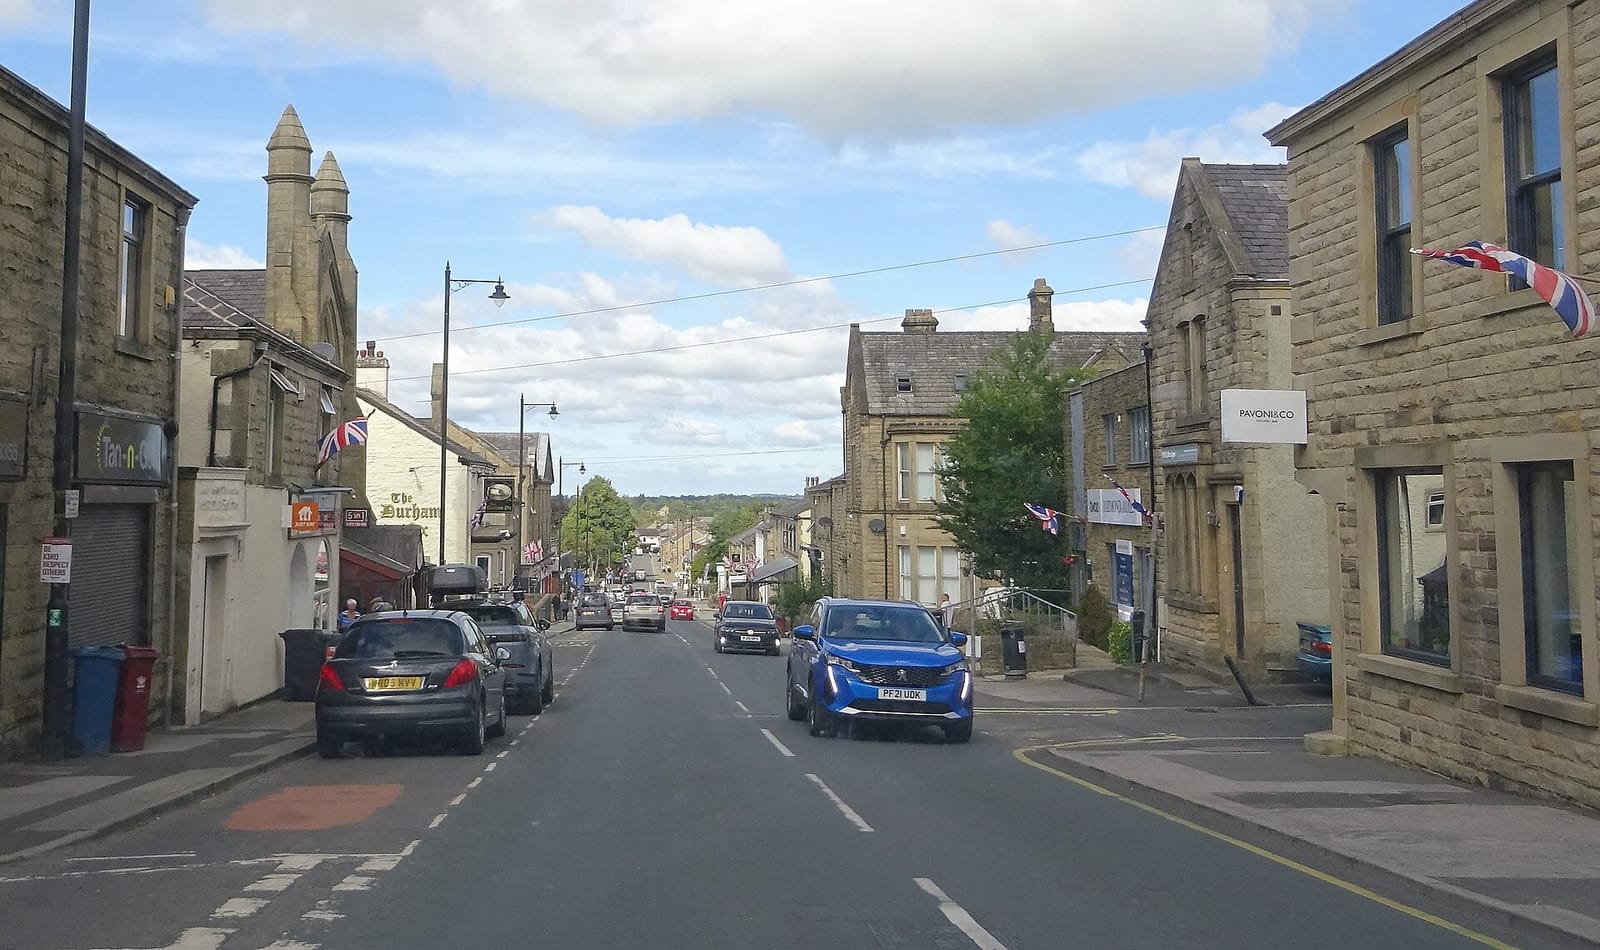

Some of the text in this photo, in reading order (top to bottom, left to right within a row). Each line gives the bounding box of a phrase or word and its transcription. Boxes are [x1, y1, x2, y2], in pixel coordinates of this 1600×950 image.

[1240, 409, 1294, 419] PAVONI&CO
[391, 493, 413, 504] The
[347, 512, 353, 520] 5
[380, 503, 441, 521] Durham
[42, 568, 66, 576] OTHERS
[883, 689, 921, 699] PF21 UDK
